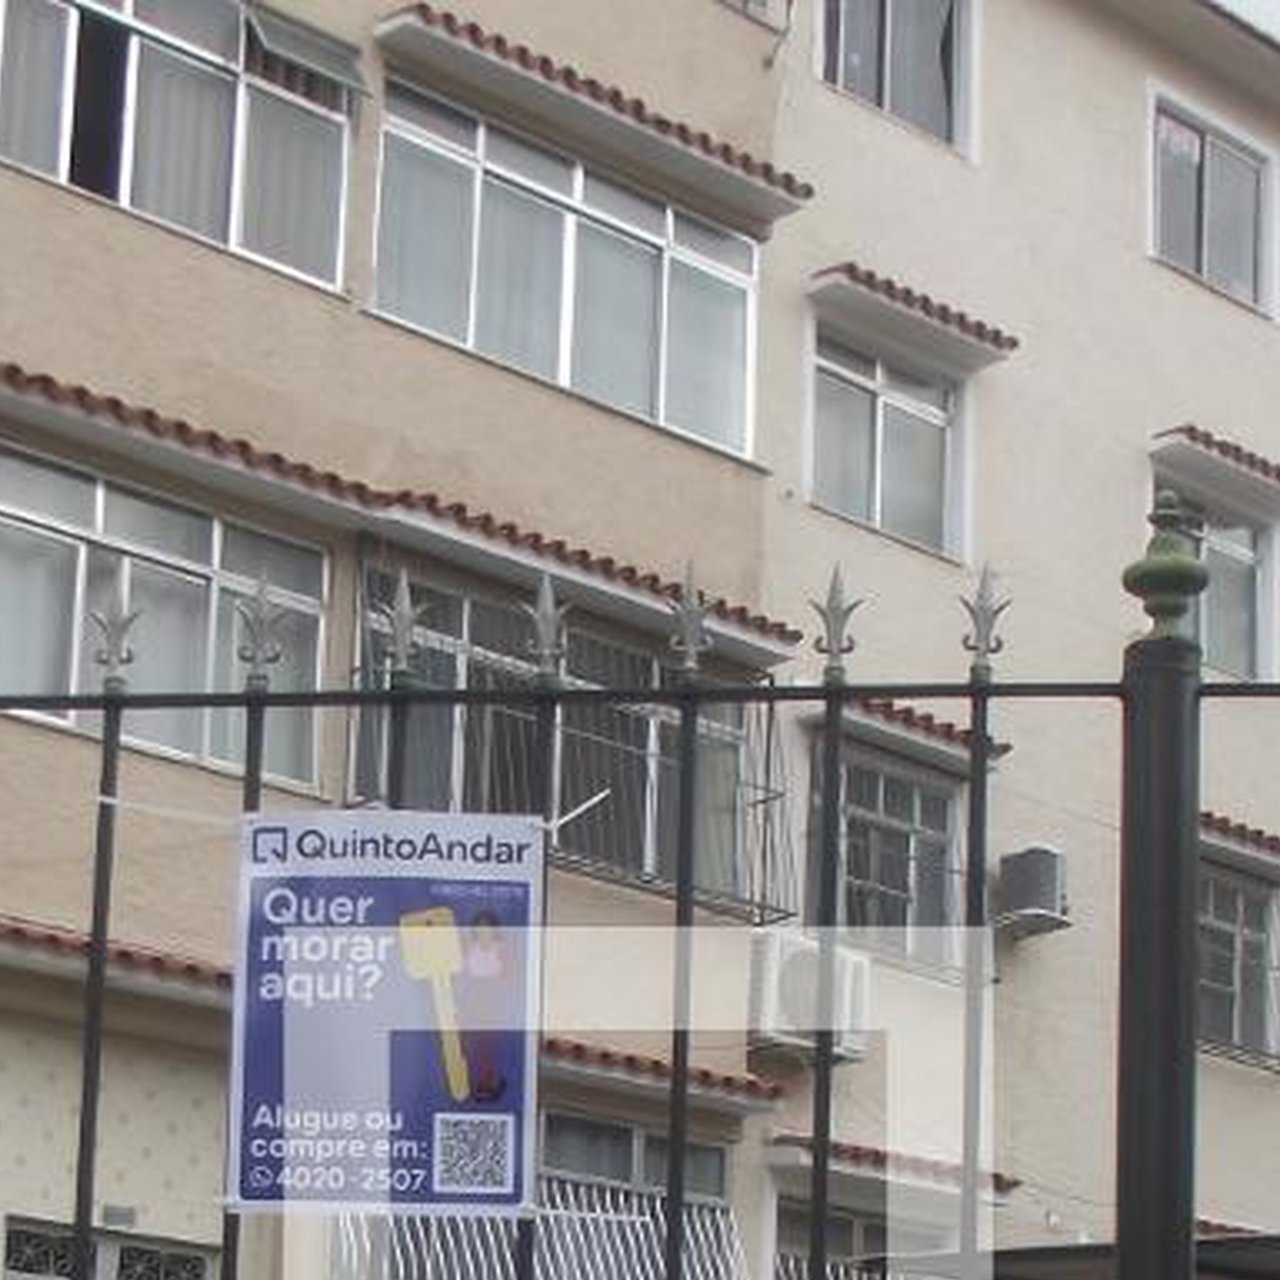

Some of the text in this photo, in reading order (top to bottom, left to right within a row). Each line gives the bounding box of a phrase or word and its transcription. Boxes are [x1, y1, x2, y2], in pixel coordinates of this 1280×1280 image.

[296, 829, 532, 864] QuintoAndar
[263, 888, 375, 924] Quer
[260, 932, 395, 962] morar
[259, 964, 384, 1005] aqui?
[252, 1104, 404, 1136] Alugue ou
[250, 1137, 429, 1162] compre em:
